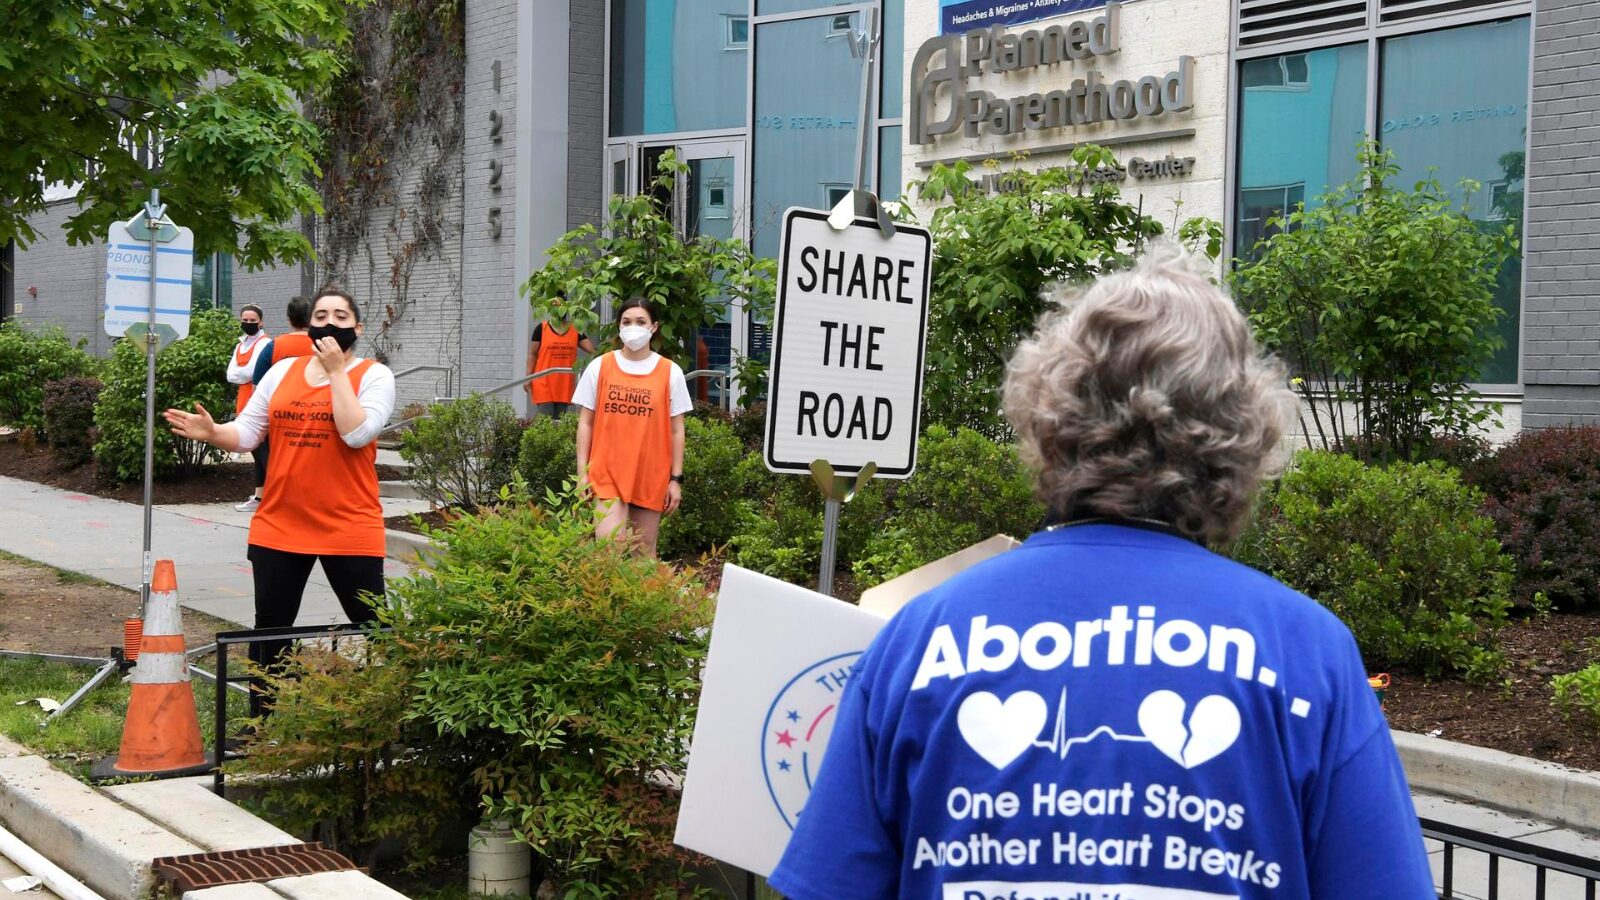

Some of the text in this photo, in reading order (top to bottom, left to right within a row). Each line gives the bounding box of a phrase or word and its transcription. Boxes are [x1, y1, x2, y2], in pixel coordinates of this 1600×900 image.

[952, 10, 988, 25] Headaches
[988, 8, 995, 18] &
[995, 3, 1029, 18] Migraines
[966, 2, 1121, 76] Planned
[964, 55, 1195, 138] Parenthood
[488, 59, 503, 240] 1225
[1127, 155, 1196, 179] Center
[797, 246, 915, 304] SHARE
[820, 320, 885, 371] THE
[604, 403, 654, 418] ESCORT
[608, 384, 652, 396] PRO-CHOICE
[608, 391, 651, 405] CLINIC
[273, 410, 304, 422] CLINIC
[797, 390, 893, 441] ROAD
[946, 782, 1245, 831] One Heart Stops
[913, 831, 1282, 889] Another Heart Breaks
